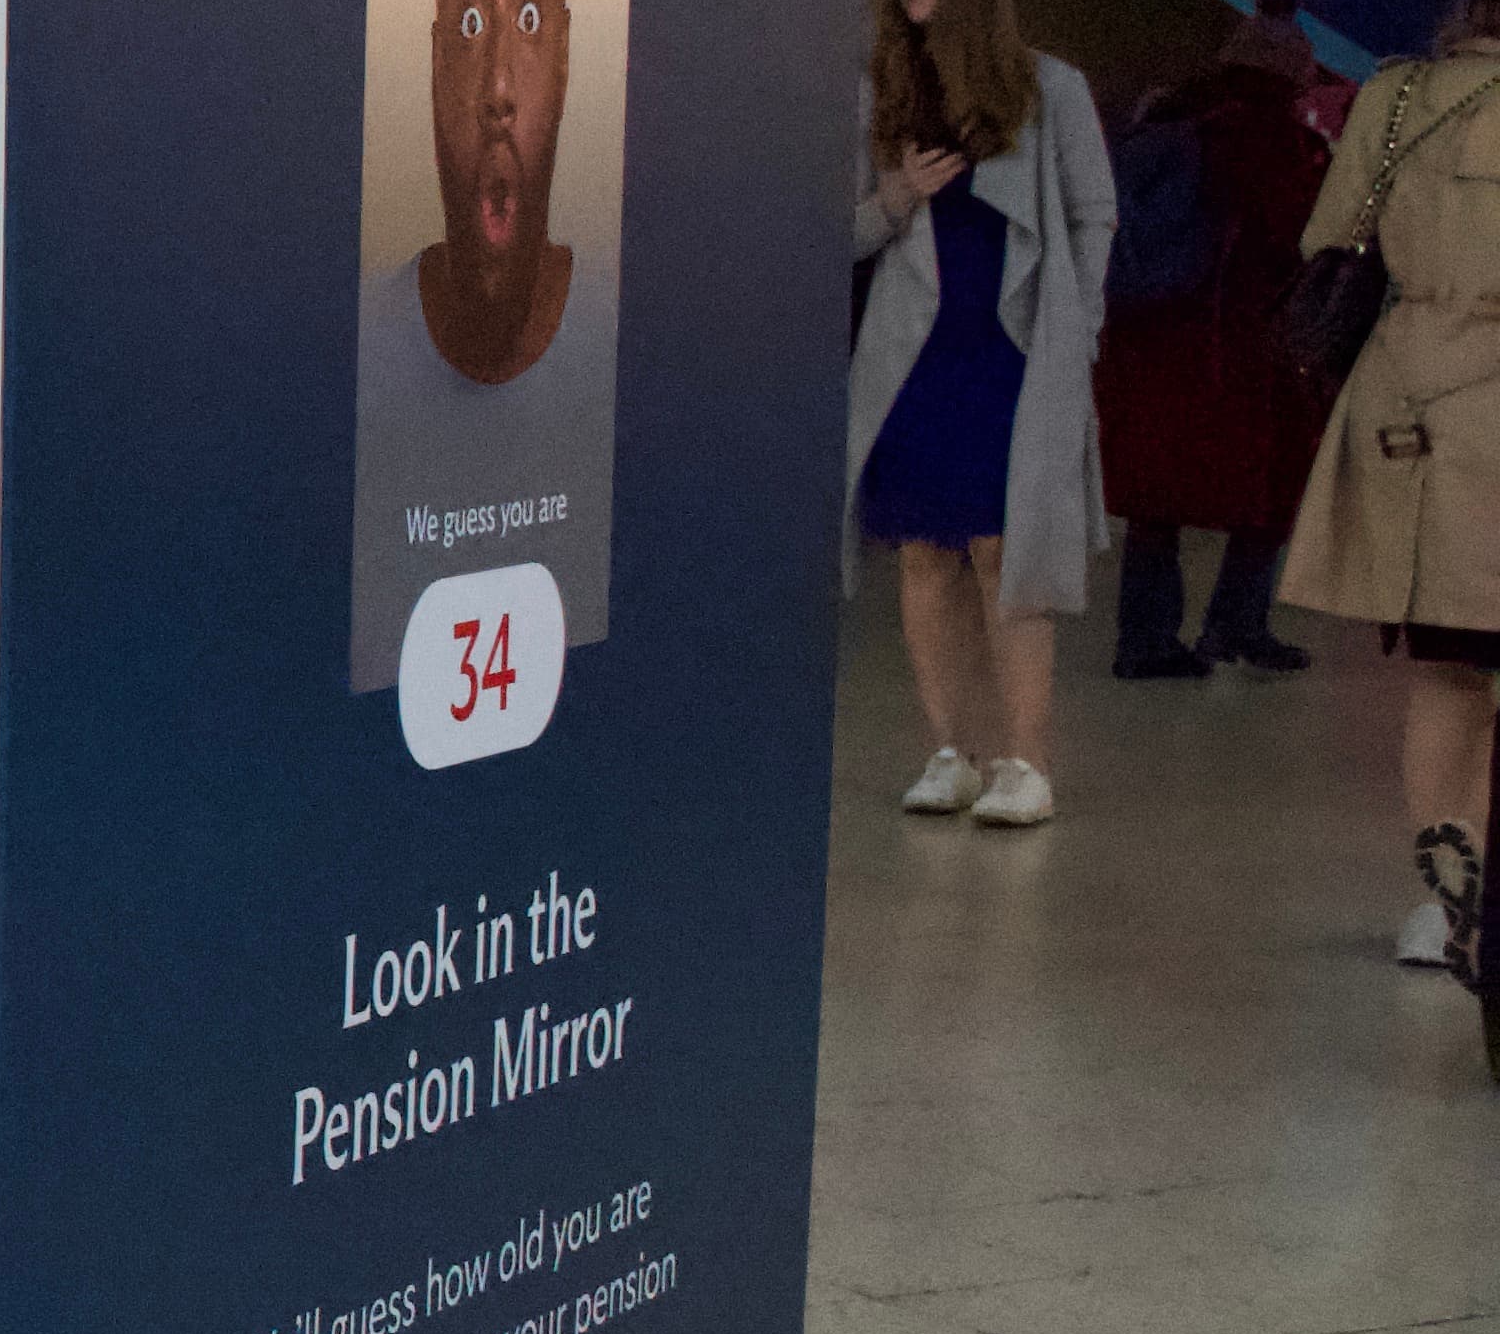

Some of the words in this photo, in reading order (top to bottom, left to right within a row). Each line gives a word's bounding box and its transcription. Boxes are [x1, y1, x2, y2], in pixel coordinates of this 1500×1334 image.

[405, 504, 439, 545] We
[443, 500, 496, 549] guess
[500, 496, 534, 539] you
[537, 491, 568, 523] are
[450, 612, 517, 723] 34
[342, 906, 462, 1030] Look
[475, 895, 515, 985] in
[528, 872, 598, 963] the
[290, 1049, 476, 1187] Pension
[490, 993, 634, 1111] Mirror
[426, 1253, 491, 1318] how
[498, 1208, 544, 1286] old
[552, 1201, 602, 1274] you
[609, 1178, 653, 1234] are
